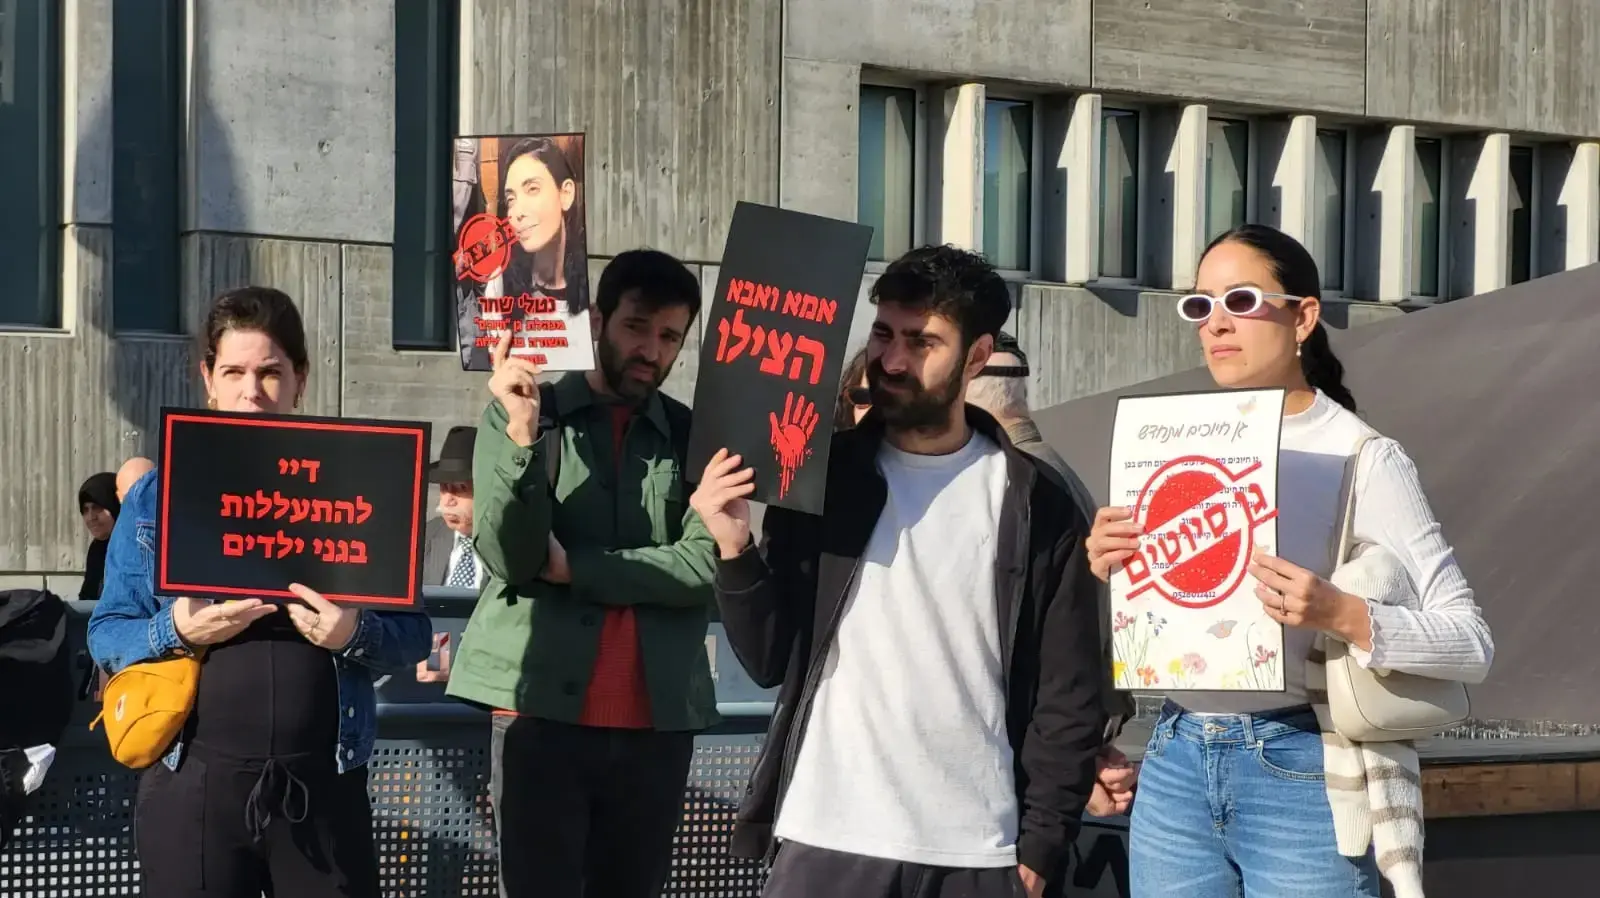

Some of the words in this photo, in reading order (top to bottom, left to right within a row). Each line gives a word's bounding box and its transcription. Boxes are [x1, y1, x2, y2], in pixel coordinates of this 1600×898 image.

[478, 296, 515, 314] שחר
[518, 293, 557, 315] נטלי
[726, 277, 780, 312] ואבא
[782, 289, 837, 325] אמא
[716, 308, 825, 385] הצילו
[1138, 423, 1185, 444] מתחדש
[1186, 421, 1231, 439] חיוכים
[1231, 420, 1249, 443] גן
[278, 457, 321, 483] דיי
[220, 489, 374, 525] להתעללות
[1235, 482, 1268, 527] גן
[222, 530, 305, 559] ילדים
[312, 537, 368, 564] בגני
[1122, 502, 1229, 586] סיוטים
